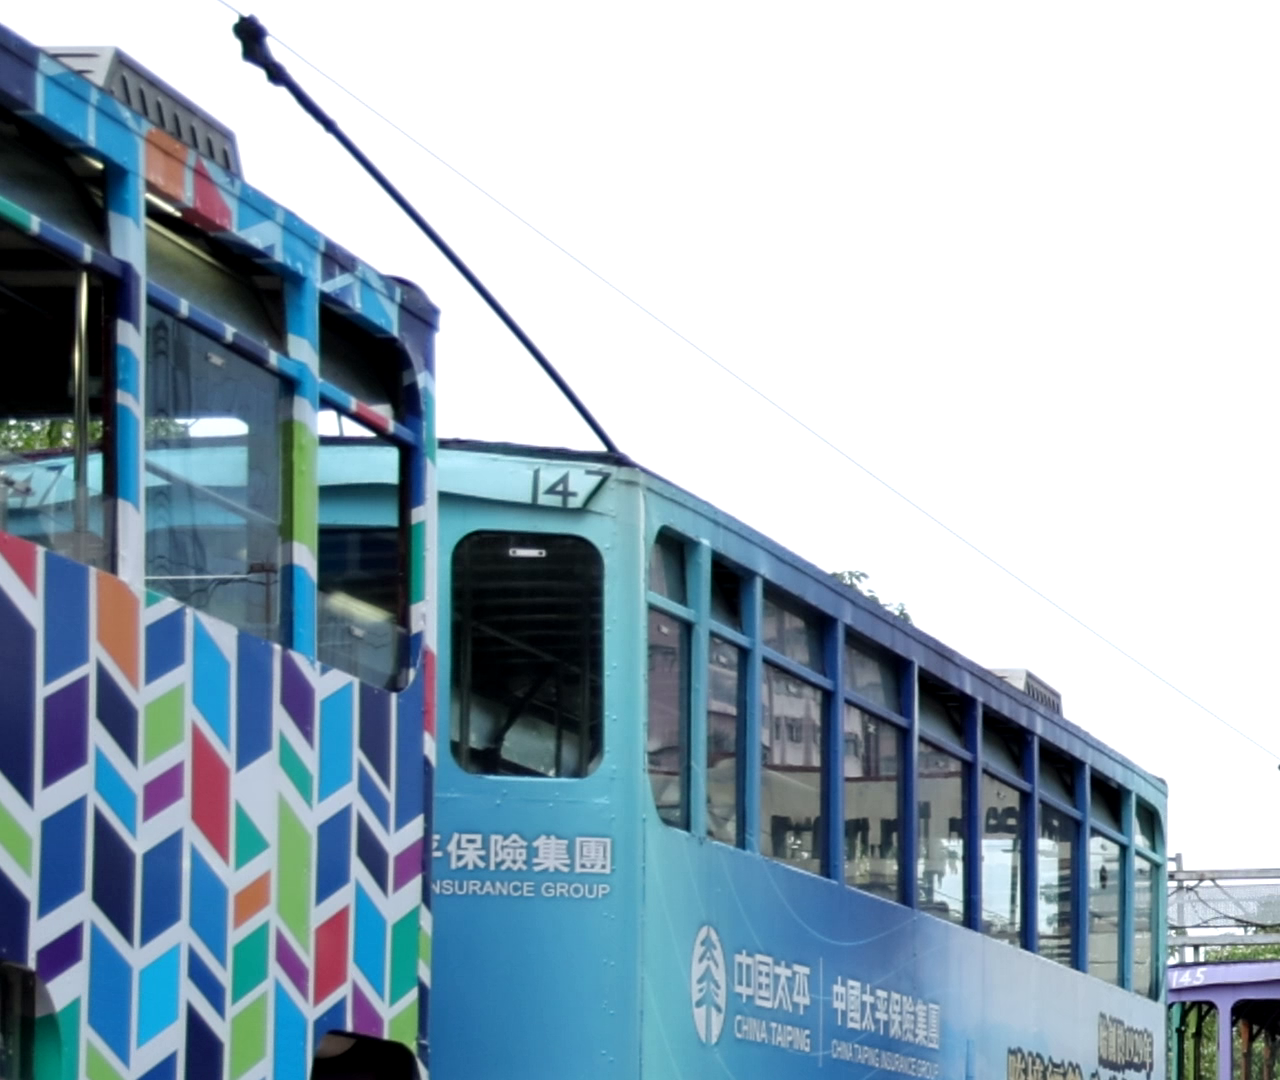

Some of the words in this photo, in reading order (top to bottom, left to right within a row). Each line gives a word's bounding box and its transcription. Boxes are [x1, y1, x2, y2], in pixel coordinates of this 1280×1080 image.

[532, 467, 612, 509] 147
[431, 880, 535, 897] NSURANCE
[541, 882, 611, 899] GROUP
[734, 949, 811, 1015] 中国太平
[1171, 968, 1207, 988] 145
[734, 1015, 769, 1045] CHINA
[770, 1021, 811, 1053] TAIPING
